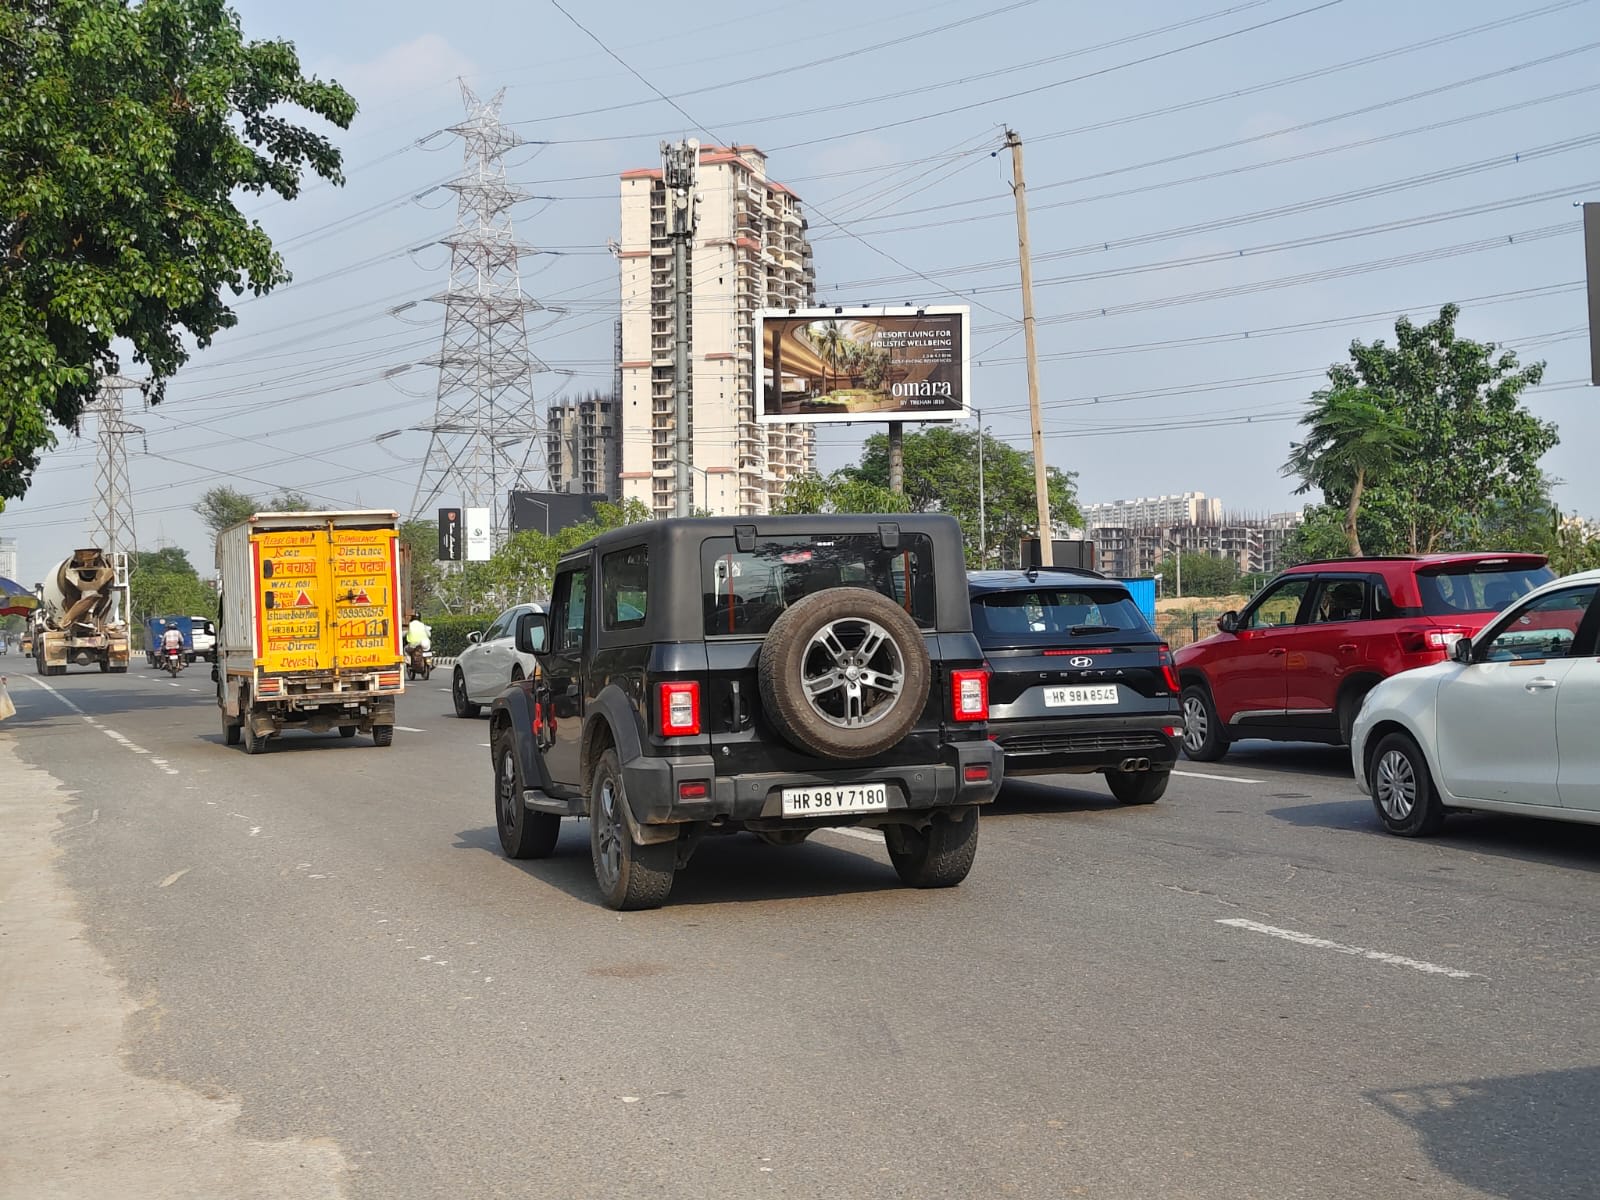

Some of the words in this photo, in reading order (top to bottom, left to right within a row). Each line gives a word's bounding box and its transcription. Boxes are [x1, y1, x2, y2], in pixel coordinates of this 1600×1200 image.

[878, 331, 907, 339] RESORT
[870, 340, 906, 348] HOLISTIC
[907, 339, 952, 347] WELLBEING
[337, 546, 383, 557] Distance
[1039, 670, 1124, 679] CRETA
[1052, 691, 1066, 703] HR
[793, 793, 811, 810] HR
[814, 792, 833, 808] 98
[836, 791, 844, 807] V
[848, 789, 885, 806] 7180
